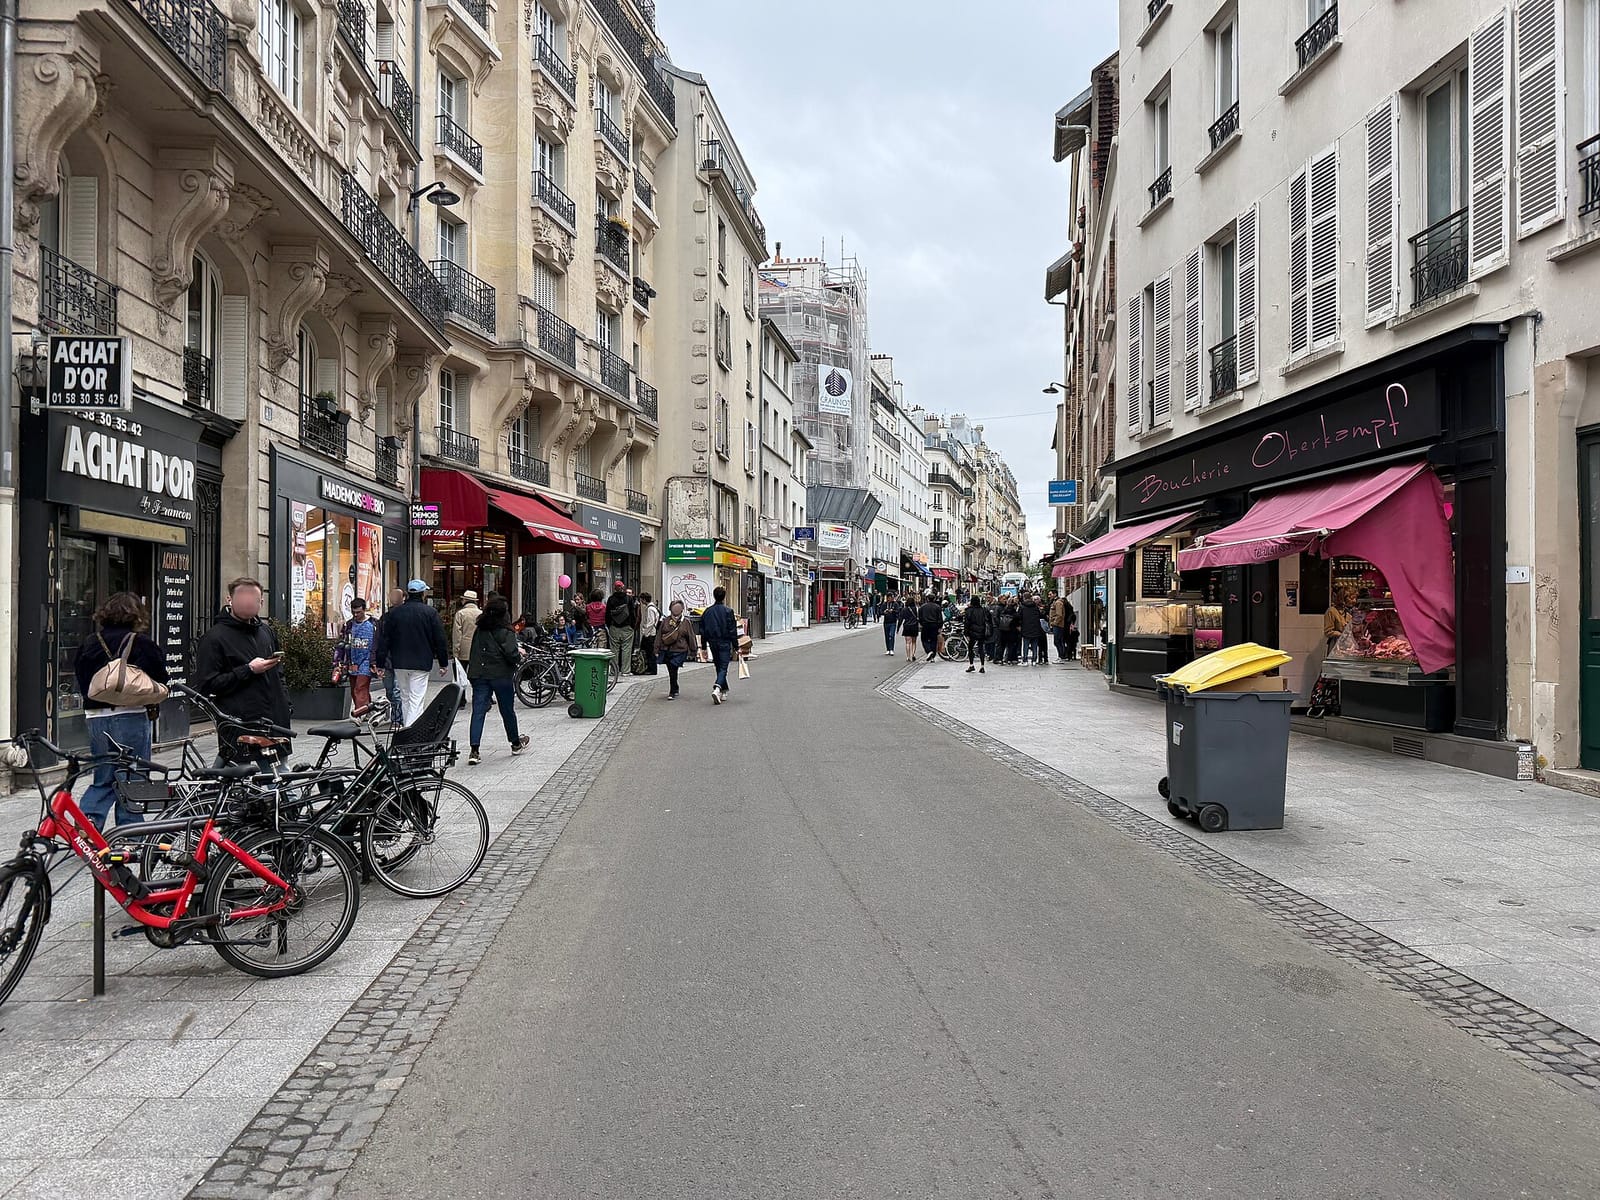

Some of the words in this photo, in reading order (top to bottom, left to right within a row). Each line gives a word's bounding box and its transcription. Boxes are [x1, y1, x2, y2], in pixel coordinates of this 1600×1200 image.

[54, 340, 119, 365] ACHAT
[63, 366, 108, 391] D'OR
[51, 392, 62, 404] 01
[65, 392, 76, 404] 58
[79, 393, 90, 404] 30
[94, 393, 104, 405] 35
[108, 393, 119, 405] 42
[99, 412, 112, 427] 30
[116, 416, 128, 432] 35
[131, 421, 142, 437] 42
[1131, 458, 1231, 504] Boucherie
[1251, 382, 1409, 469] Oberkampf
[62, 424, 145, 489] ACHAT
[147, 449, 195, 501] D'OR
[412, 504, 424, 512] MA
[412, 511, 439, 519] DEMOIS
[434, 529, 457, 537] DEUX
